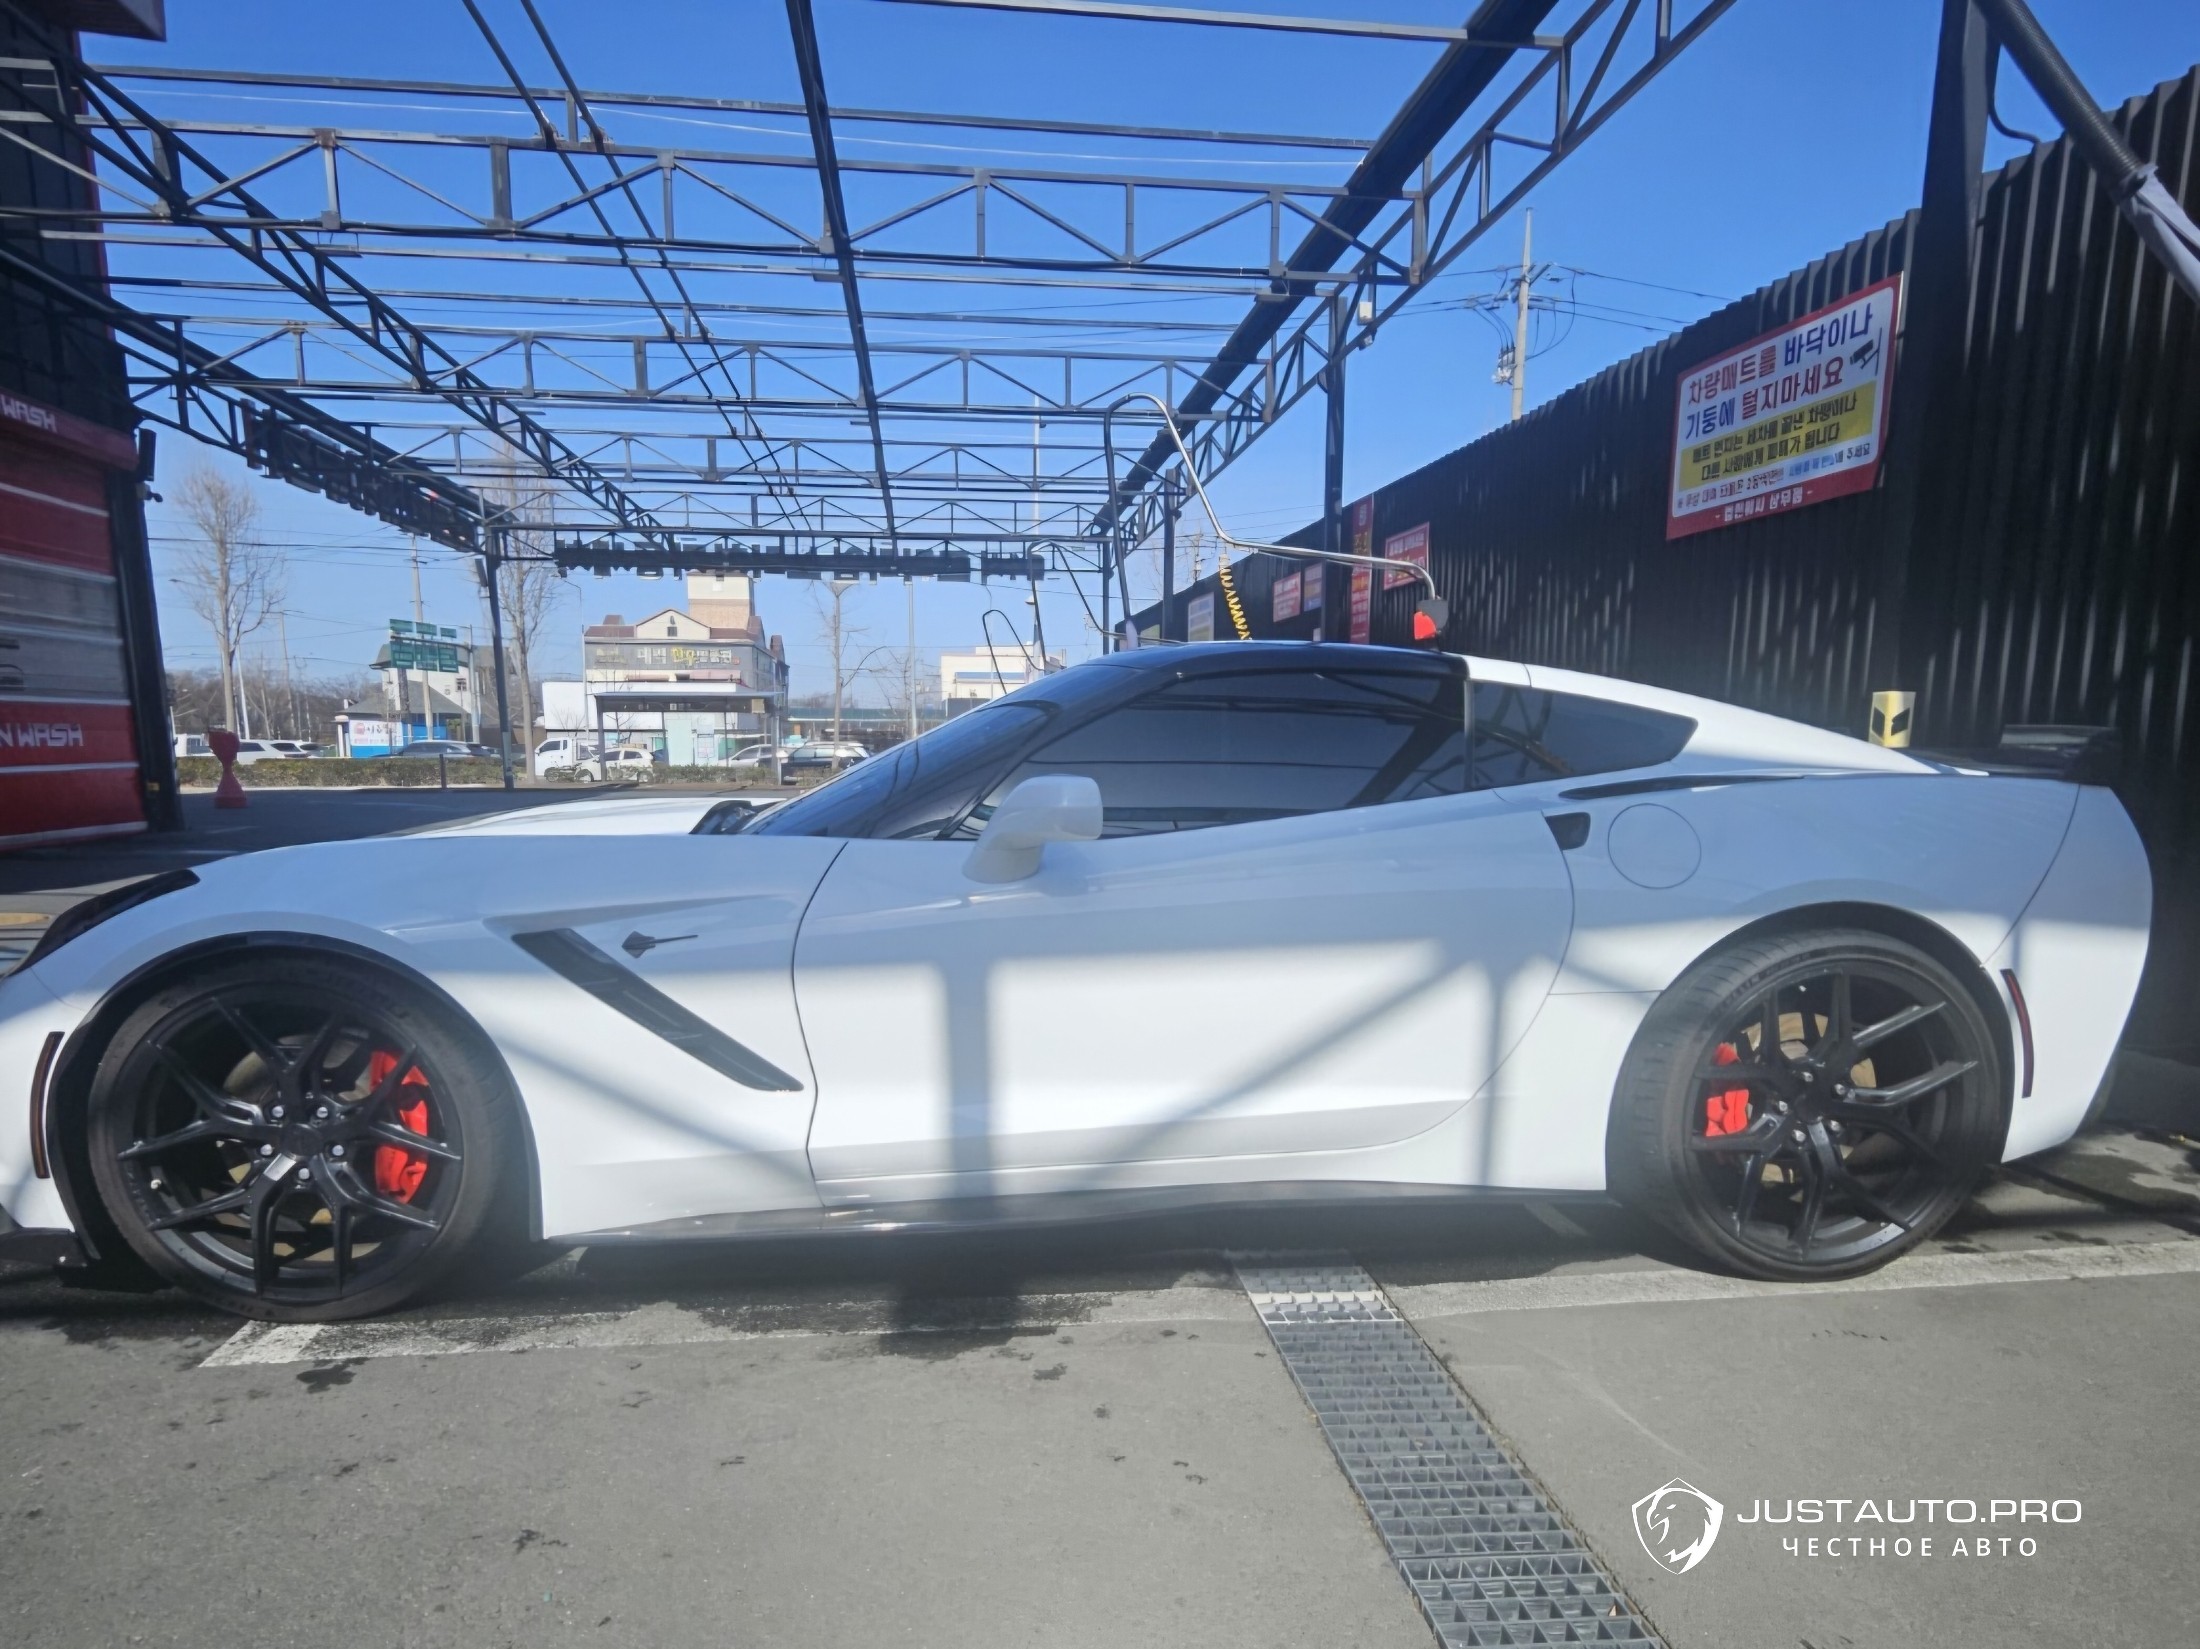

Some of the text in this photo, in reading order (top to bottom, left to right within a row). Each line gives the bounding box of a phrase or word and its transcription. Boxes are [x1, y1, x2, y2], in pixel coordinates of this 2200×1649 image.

[1689, 301, 1873, 406] 차량매트를 바닥이나
[1, 395, 56, 432] WASH
[1686, 353, 1844, 440] 기둥에 털지마세요
[1805, 422, 1839, 448] 됩니다
[17, 723, 83, 747] WASH
